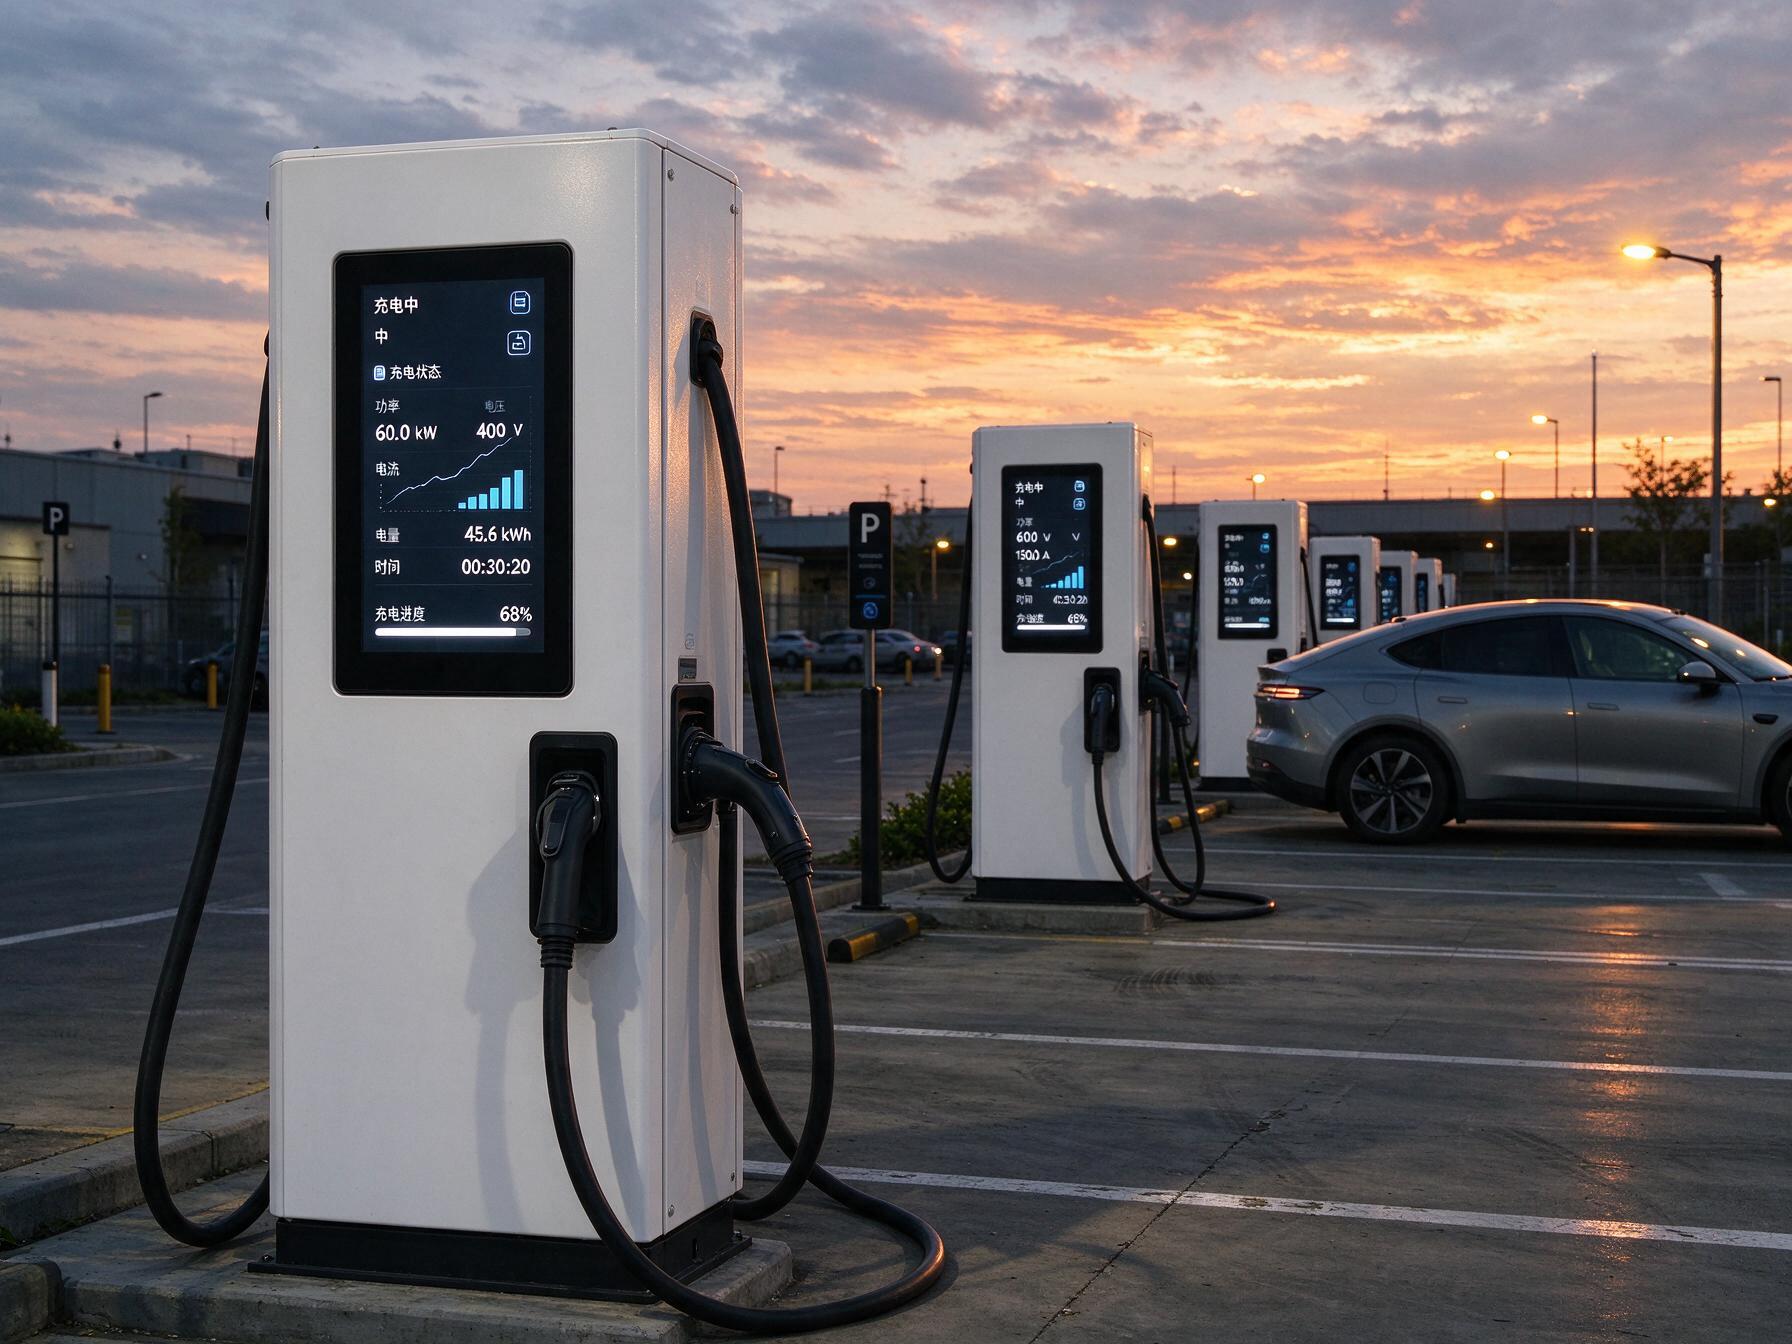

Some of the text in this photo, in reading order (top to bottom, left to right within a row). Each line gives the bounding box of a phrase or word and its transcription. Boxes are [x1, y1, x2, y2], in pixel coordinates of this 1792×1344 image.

[374, 296, 418, 315] 充电中
[375, 327, 388, 345] 中
[389, 364, 442, 380] 充电状态
[375, 398, 400, 414] 功率
[375, 424, 437, 441] 60.0 kW
[476, 423, 523, 439] 400 V
[375, 461, 400, 477] 电流
[49, 507, 64, 531] P
[375, 527, 400, 543] 电量
[464, 525, 532, 543] 45.6 kWh
[861, 513, 880, 543] P
[1016, 531, 1038, 543] 600
[1072, 532, 1080, 542] V
[1042, 550, 1050, 560] A
[375, 559, 400, 575] 时间
[461, 558, 531, 575] 00:30:20
[375, 605, 426, 622] 充电进度
[500, 605, 533, 622] 68%
